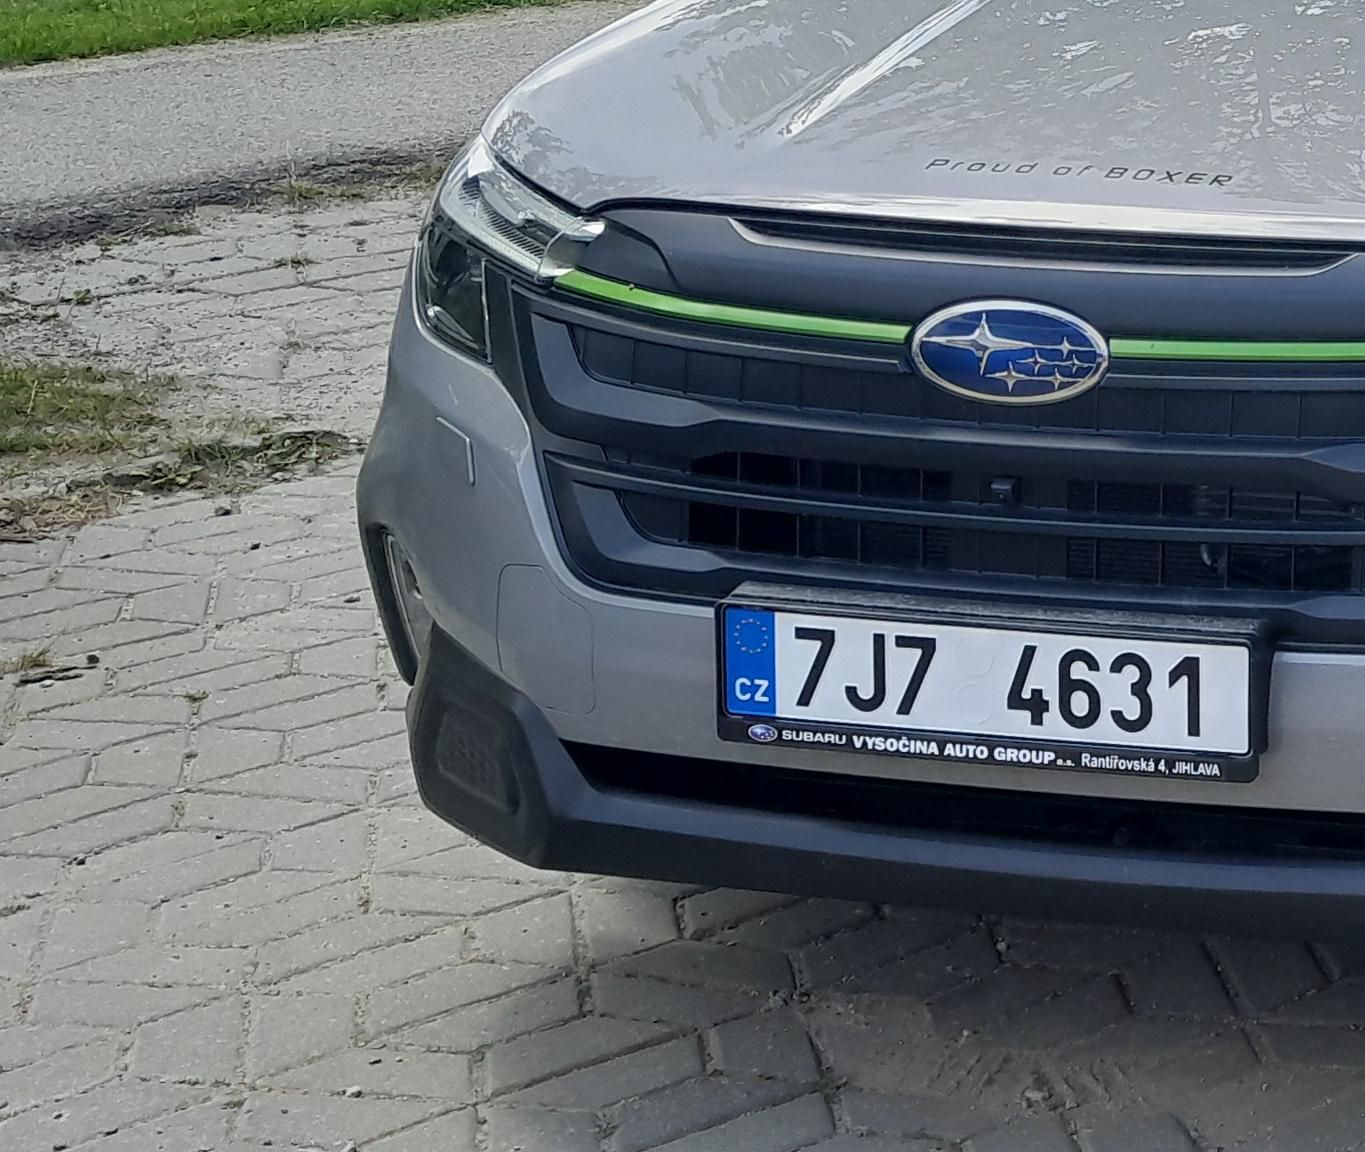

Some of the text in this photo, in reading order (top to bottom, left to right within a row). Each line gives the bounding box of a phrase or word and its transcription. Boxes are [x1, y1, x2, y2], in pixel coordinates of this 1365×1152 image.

[925, 158, 1234, 188] Proud of BOXER
[734, 677, 770, 703] CZ
[793, 626, 1202, 738] 7J7 4631
[781, 729, 847, 745] SUBARU
[852, 734, 940, 756] VYSOČINA
[943, 743, 989, 760] AUTO
[993, 746, 1056, 765] GROUP
[1081, 752, 1156, 773] Rantířovská
[1157, 762, 1170, 775] 4,
[1172, 760, 1221, 777] JIHLAVA
